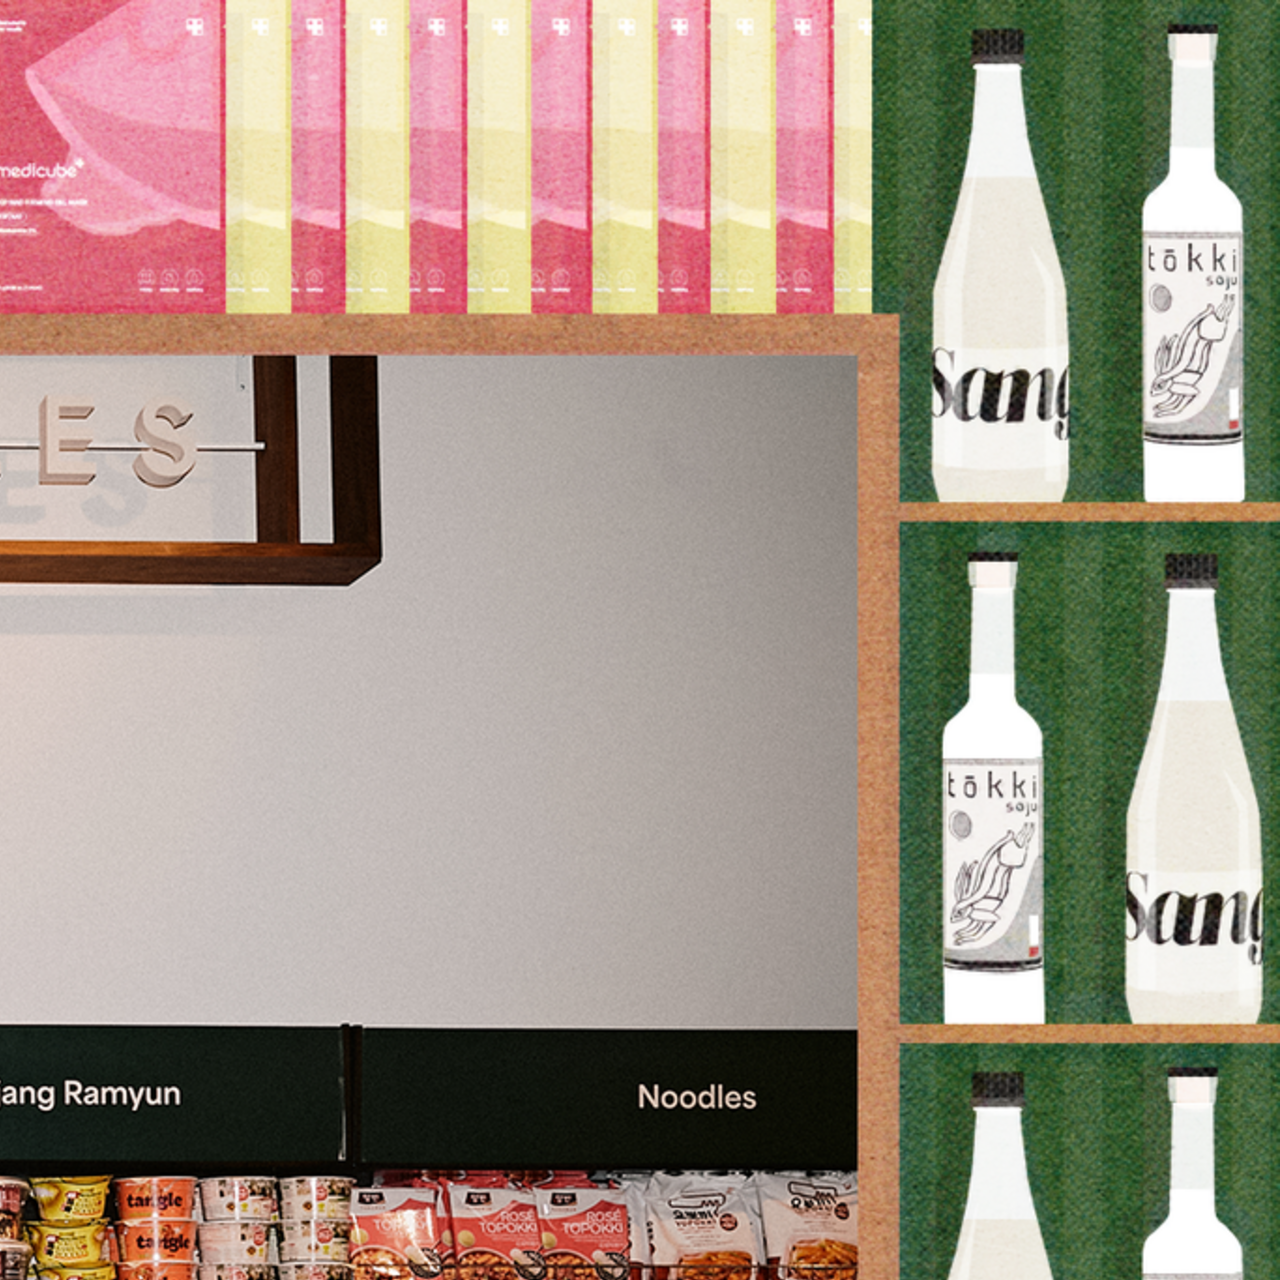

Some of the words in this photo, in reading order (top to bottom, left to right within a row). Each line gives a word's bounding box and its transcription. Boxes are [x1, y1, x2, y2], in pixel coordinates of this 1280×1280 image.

[1148, 243, 1237, 272] tōkki
[948, 771, 1037, 798] tōkki
[64, 1080, 182, 1112] Ramyun
[638, 1084, 757, 1109] Noodles
[478, 1221, 538, 1234] TOPOKKI
[562, 1221, 624, 1235] TOPOKKI
